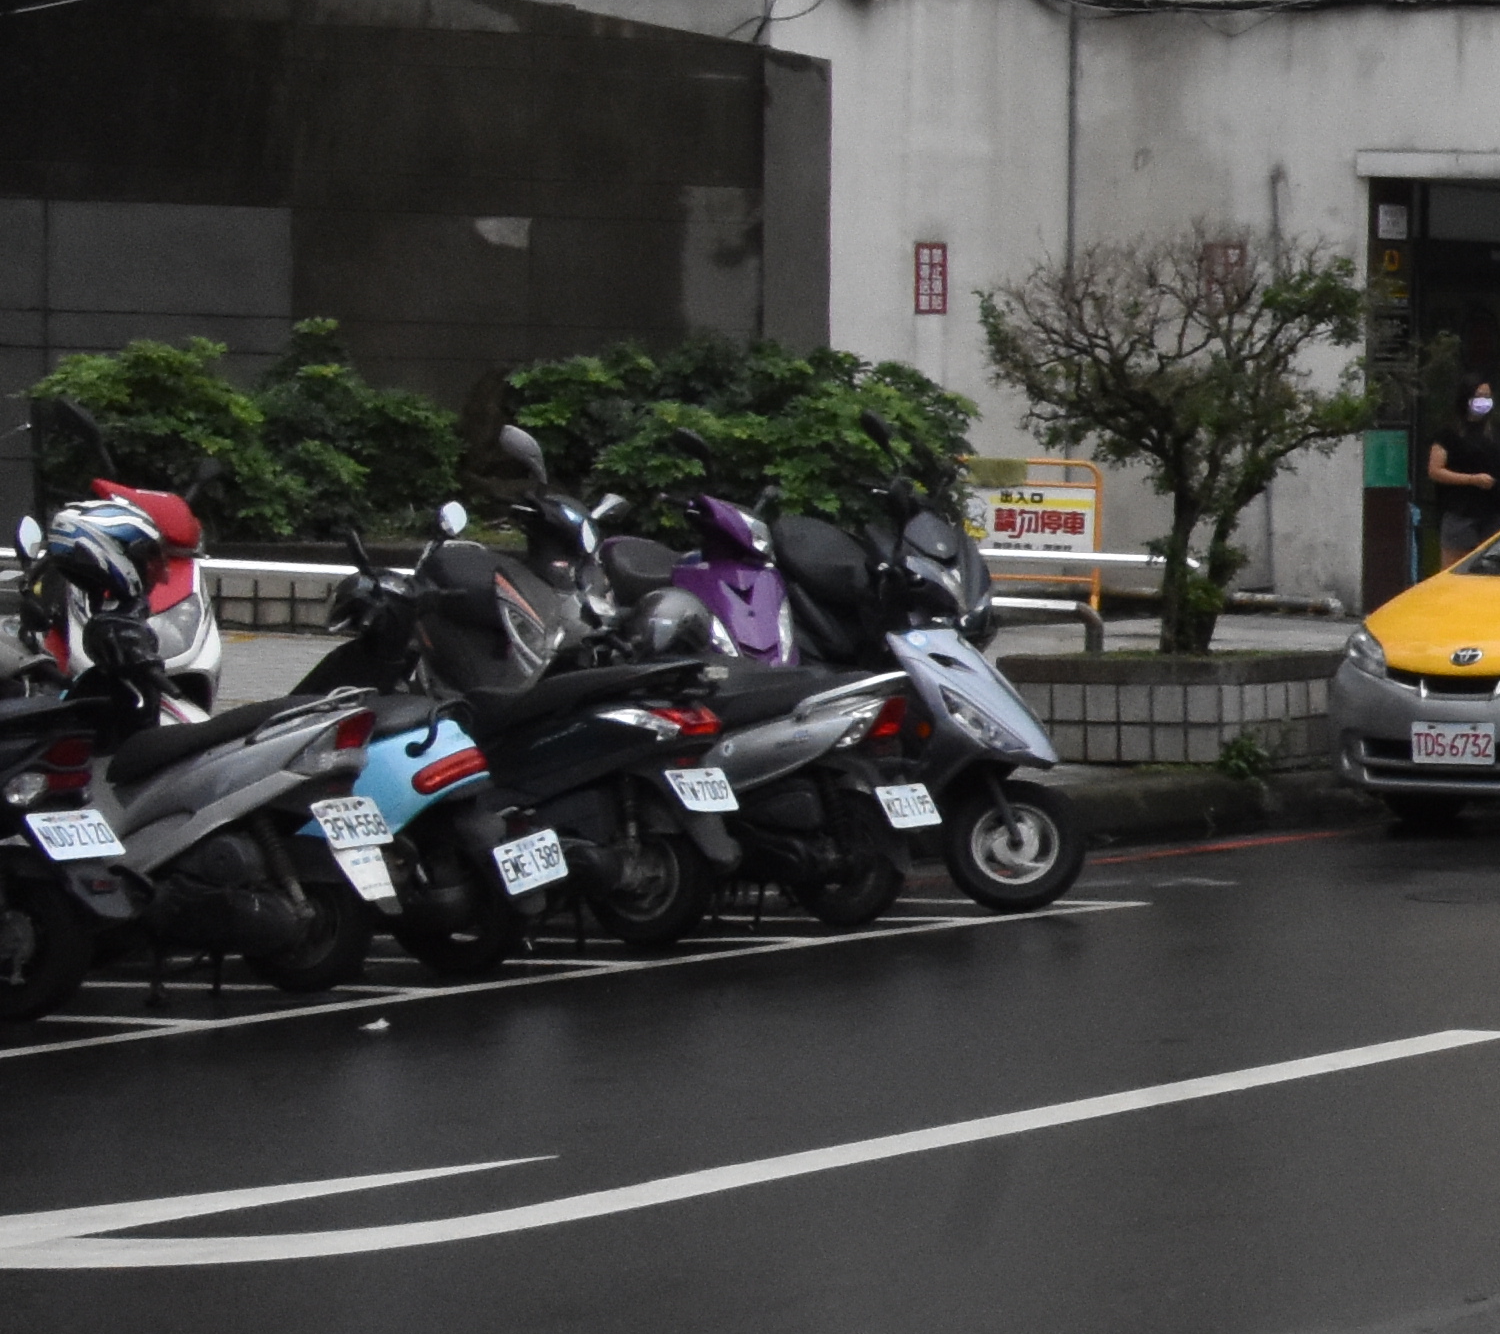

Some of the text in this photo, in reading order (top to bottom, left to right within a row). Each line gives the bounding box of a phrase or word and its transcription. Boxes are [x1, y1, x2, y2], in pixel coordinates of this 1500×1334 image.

[1000, 490, 1044, 504] 出入口
[994, 508, 1085, 538] 請勿停車
